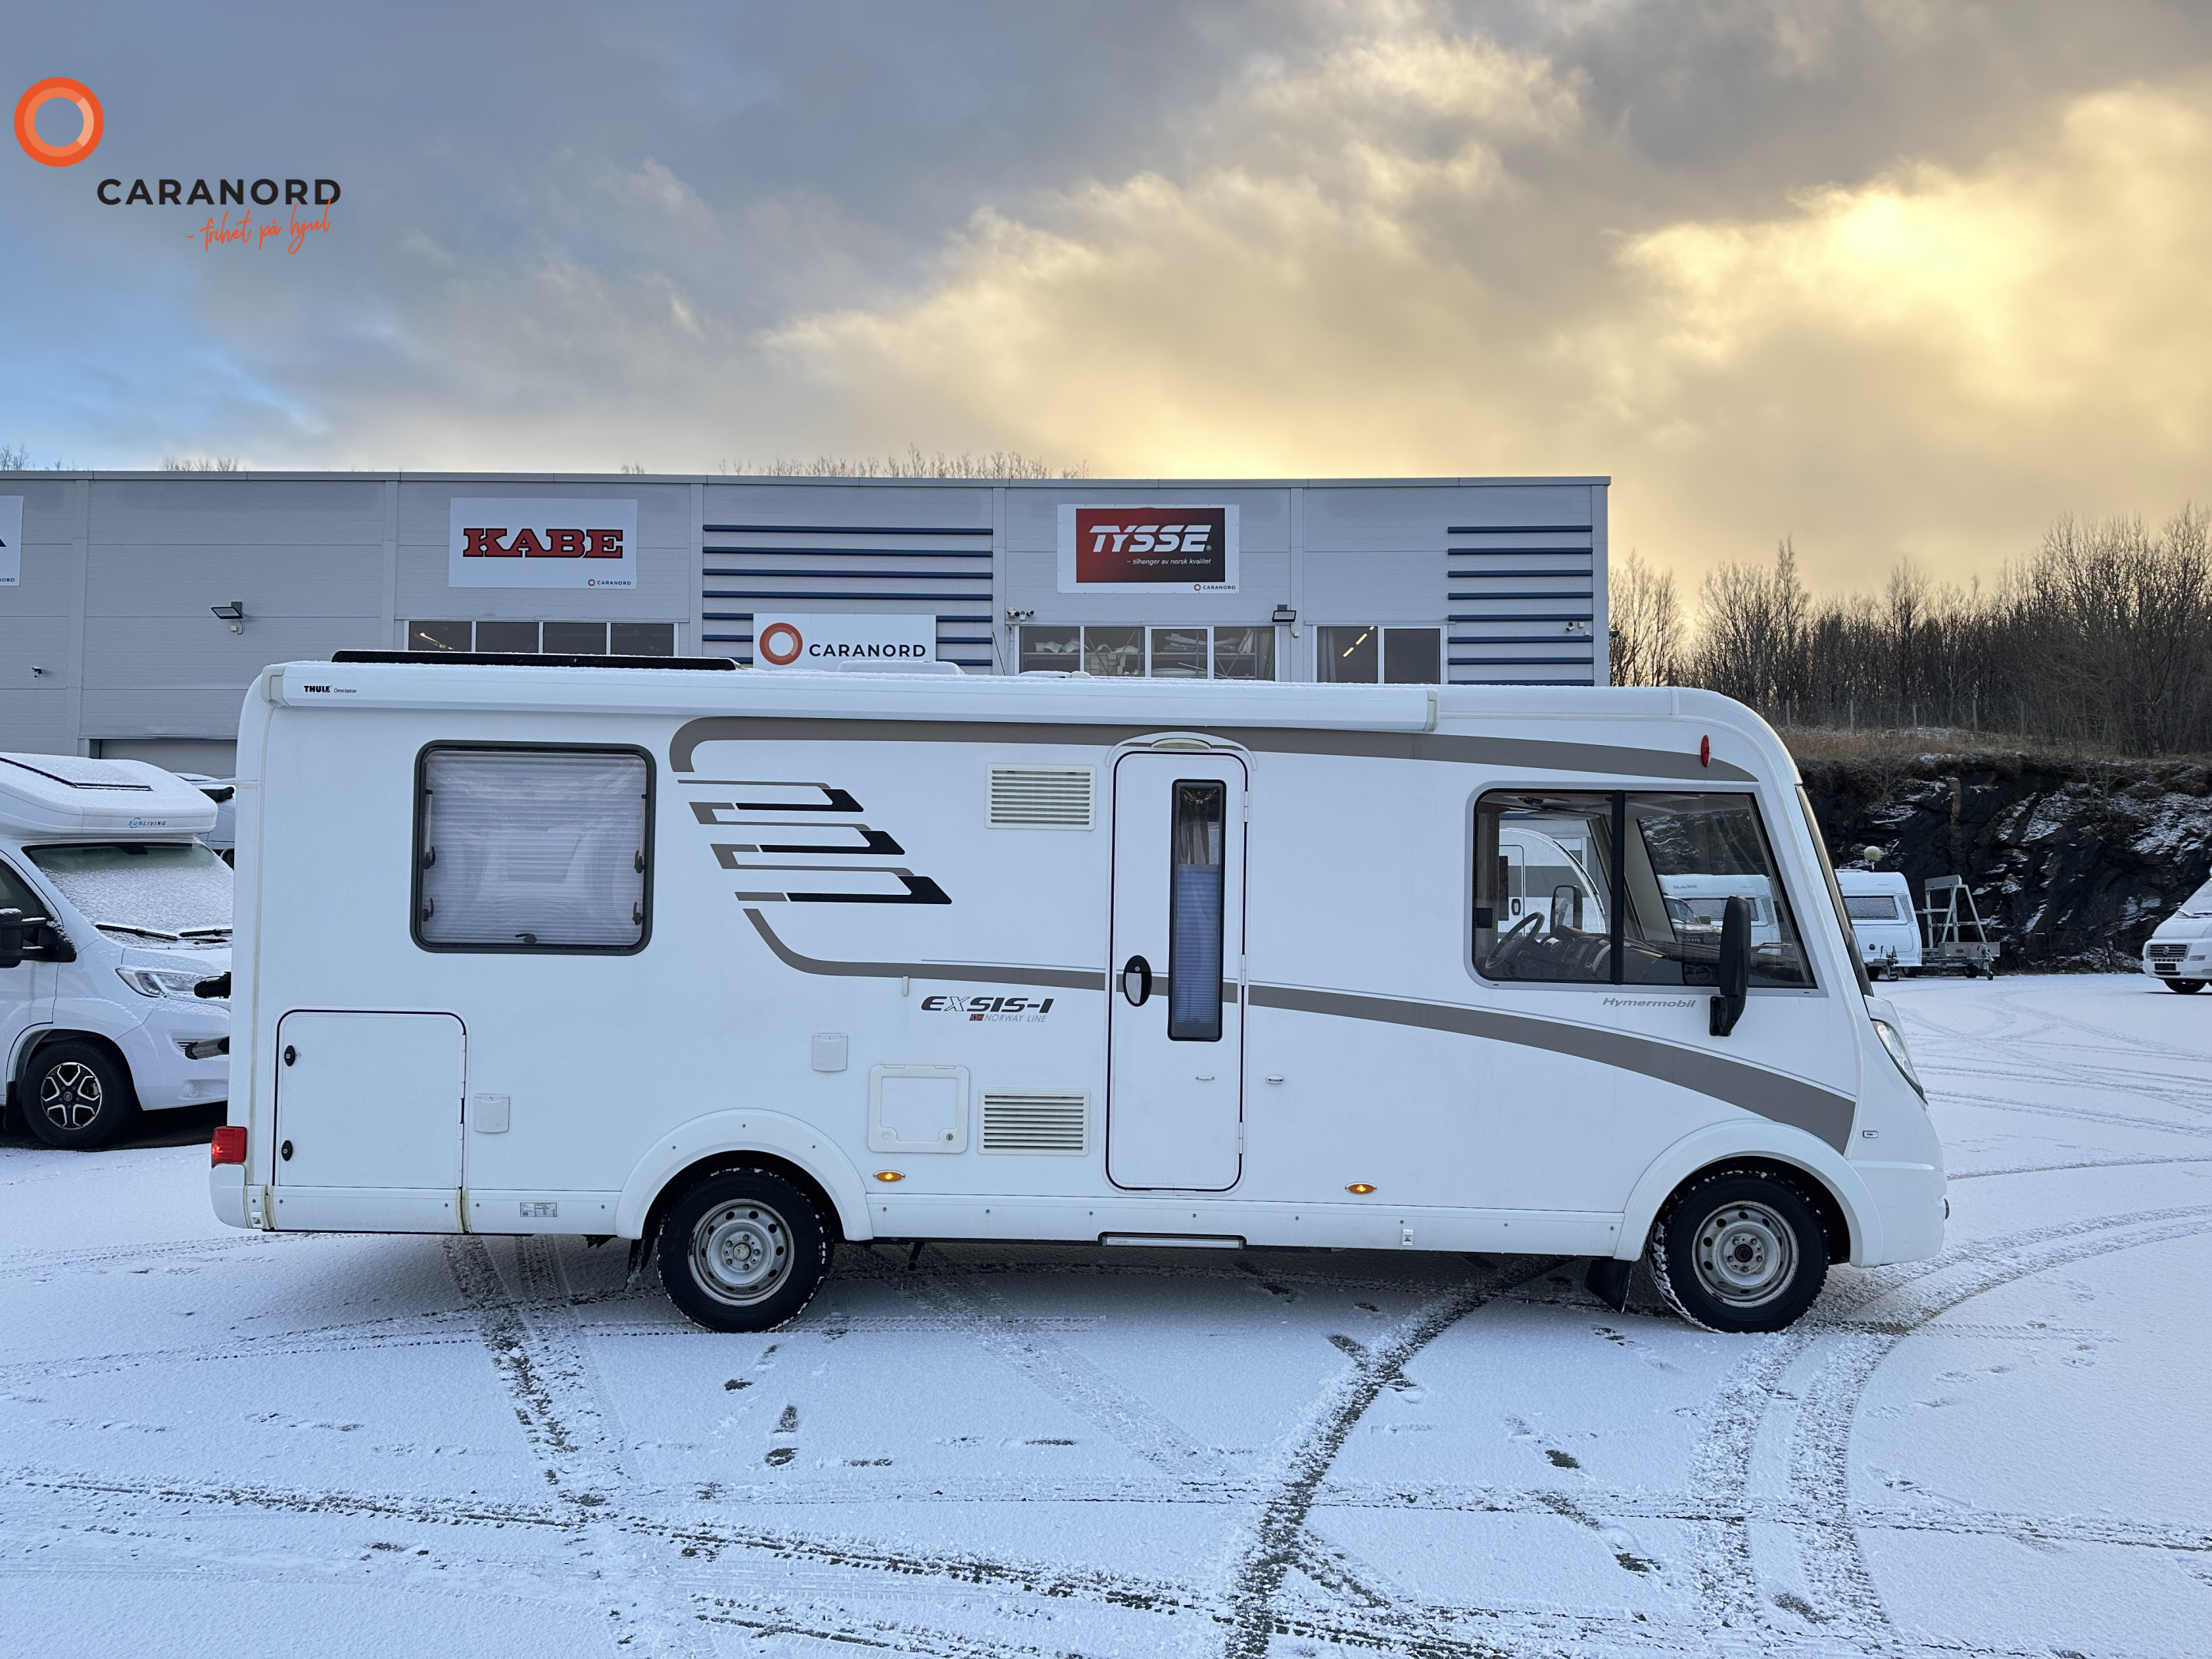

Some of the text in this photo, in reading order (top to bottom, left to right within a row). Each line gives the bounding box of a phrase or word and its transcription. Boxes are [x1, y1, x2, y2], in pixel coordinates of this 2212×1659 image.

[463, 528, 624, 559] KABE
[1132, 558, 1161, 566] tilhenger
[809, 644, 926, 657] CARANORD
[128, 819, 167, 827] SUNLIVING
[921, 995, 1055, 1014] EXSIS-I
[1602, 998, 1697, 1008] Hymermobil
[984, 1013, 1048, 1023] NORWAY LINE
